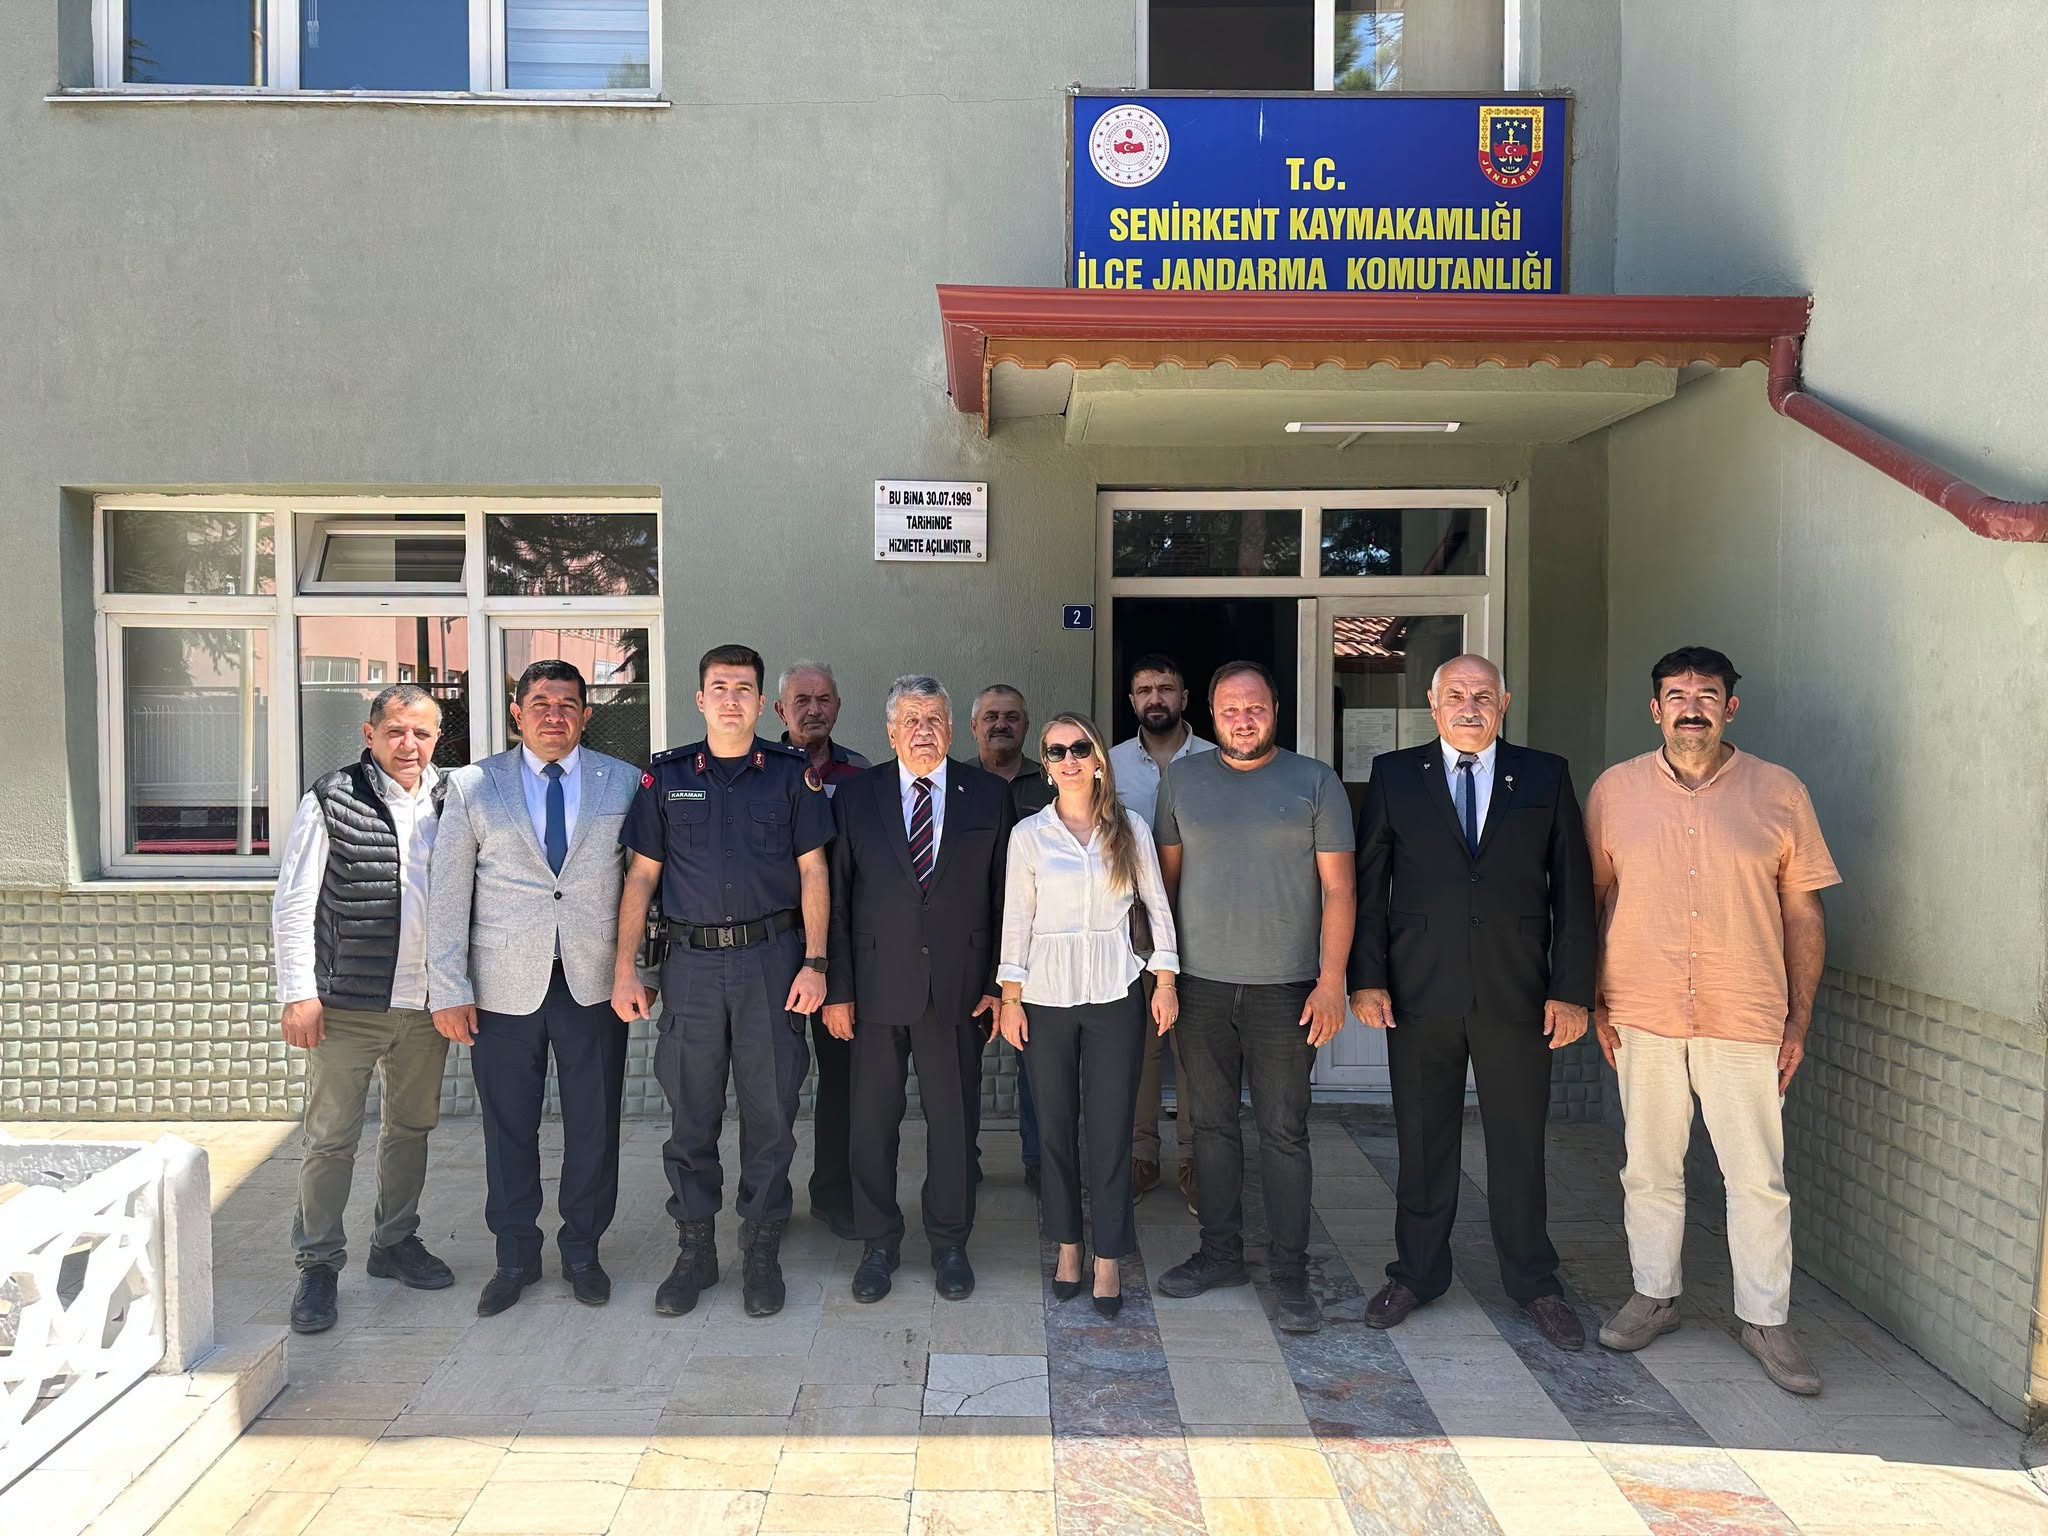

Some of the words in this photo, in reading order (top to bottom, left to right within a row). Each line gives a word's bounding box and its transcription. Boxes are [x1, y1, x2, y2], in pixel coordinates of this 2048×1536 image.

[1285, 157, 1346, 191] T.C.
[1482, 160, 1540, 185] JANDARMA
[1109, 201, 1280, 241] SENİRKENT
[1289, 201, 1521, 241] KAYMAKAMLIĞI
[1152, 257, 1327, 291] JANDARMA
[1346, 250, 1552, 291] KOMUTANLIĞI
[889, 490, 901, 505] BU
[926, 491, 972, 506] 30.07.1969
[925, 538, 972, 556] AÇILMIŞTIR
[1073, 609, 1081, 625] 2
